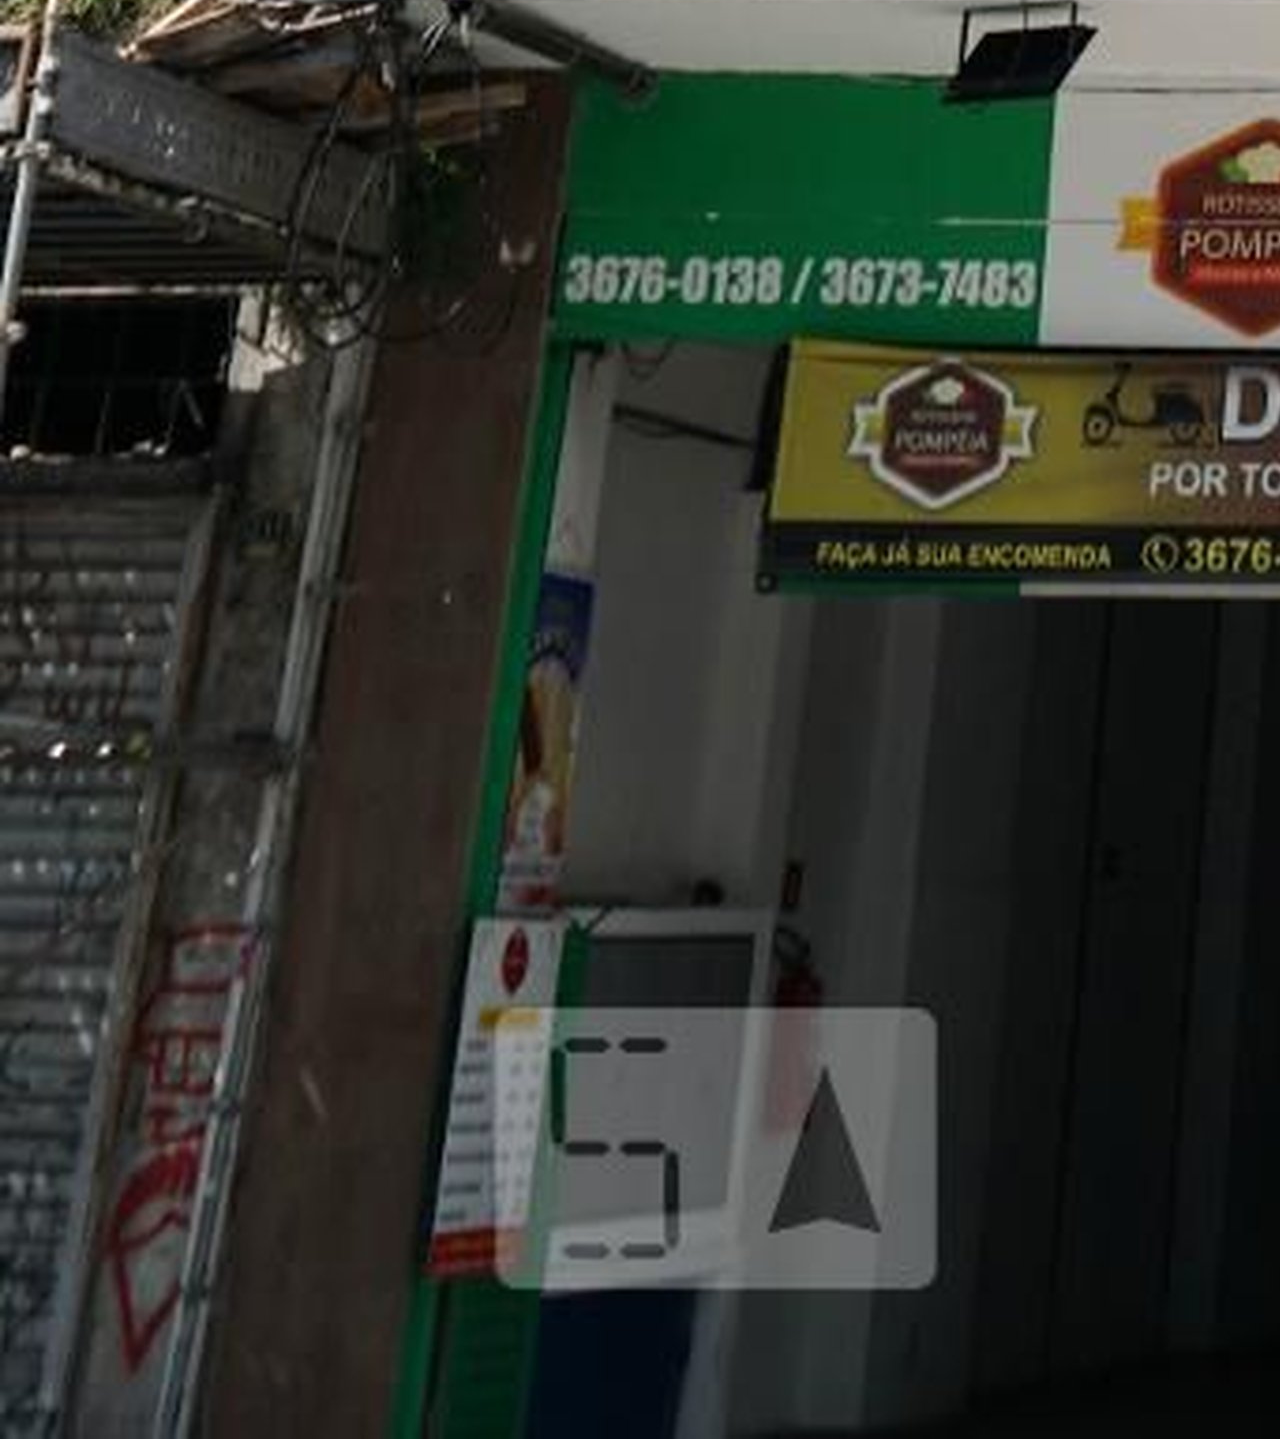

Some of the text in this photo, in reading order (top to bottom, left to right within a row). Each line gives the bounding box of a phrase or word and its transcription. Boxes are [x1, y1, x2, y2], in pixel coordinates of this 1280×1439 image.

[565, 255, 783, 305] 3676-0138
[820, 258, 1037, 308] 3673-7483
[1149, 461, 1228, 499] POR
[816, 536, 1112, 570] FAÇA JÁ SUA ENCOMENDA
